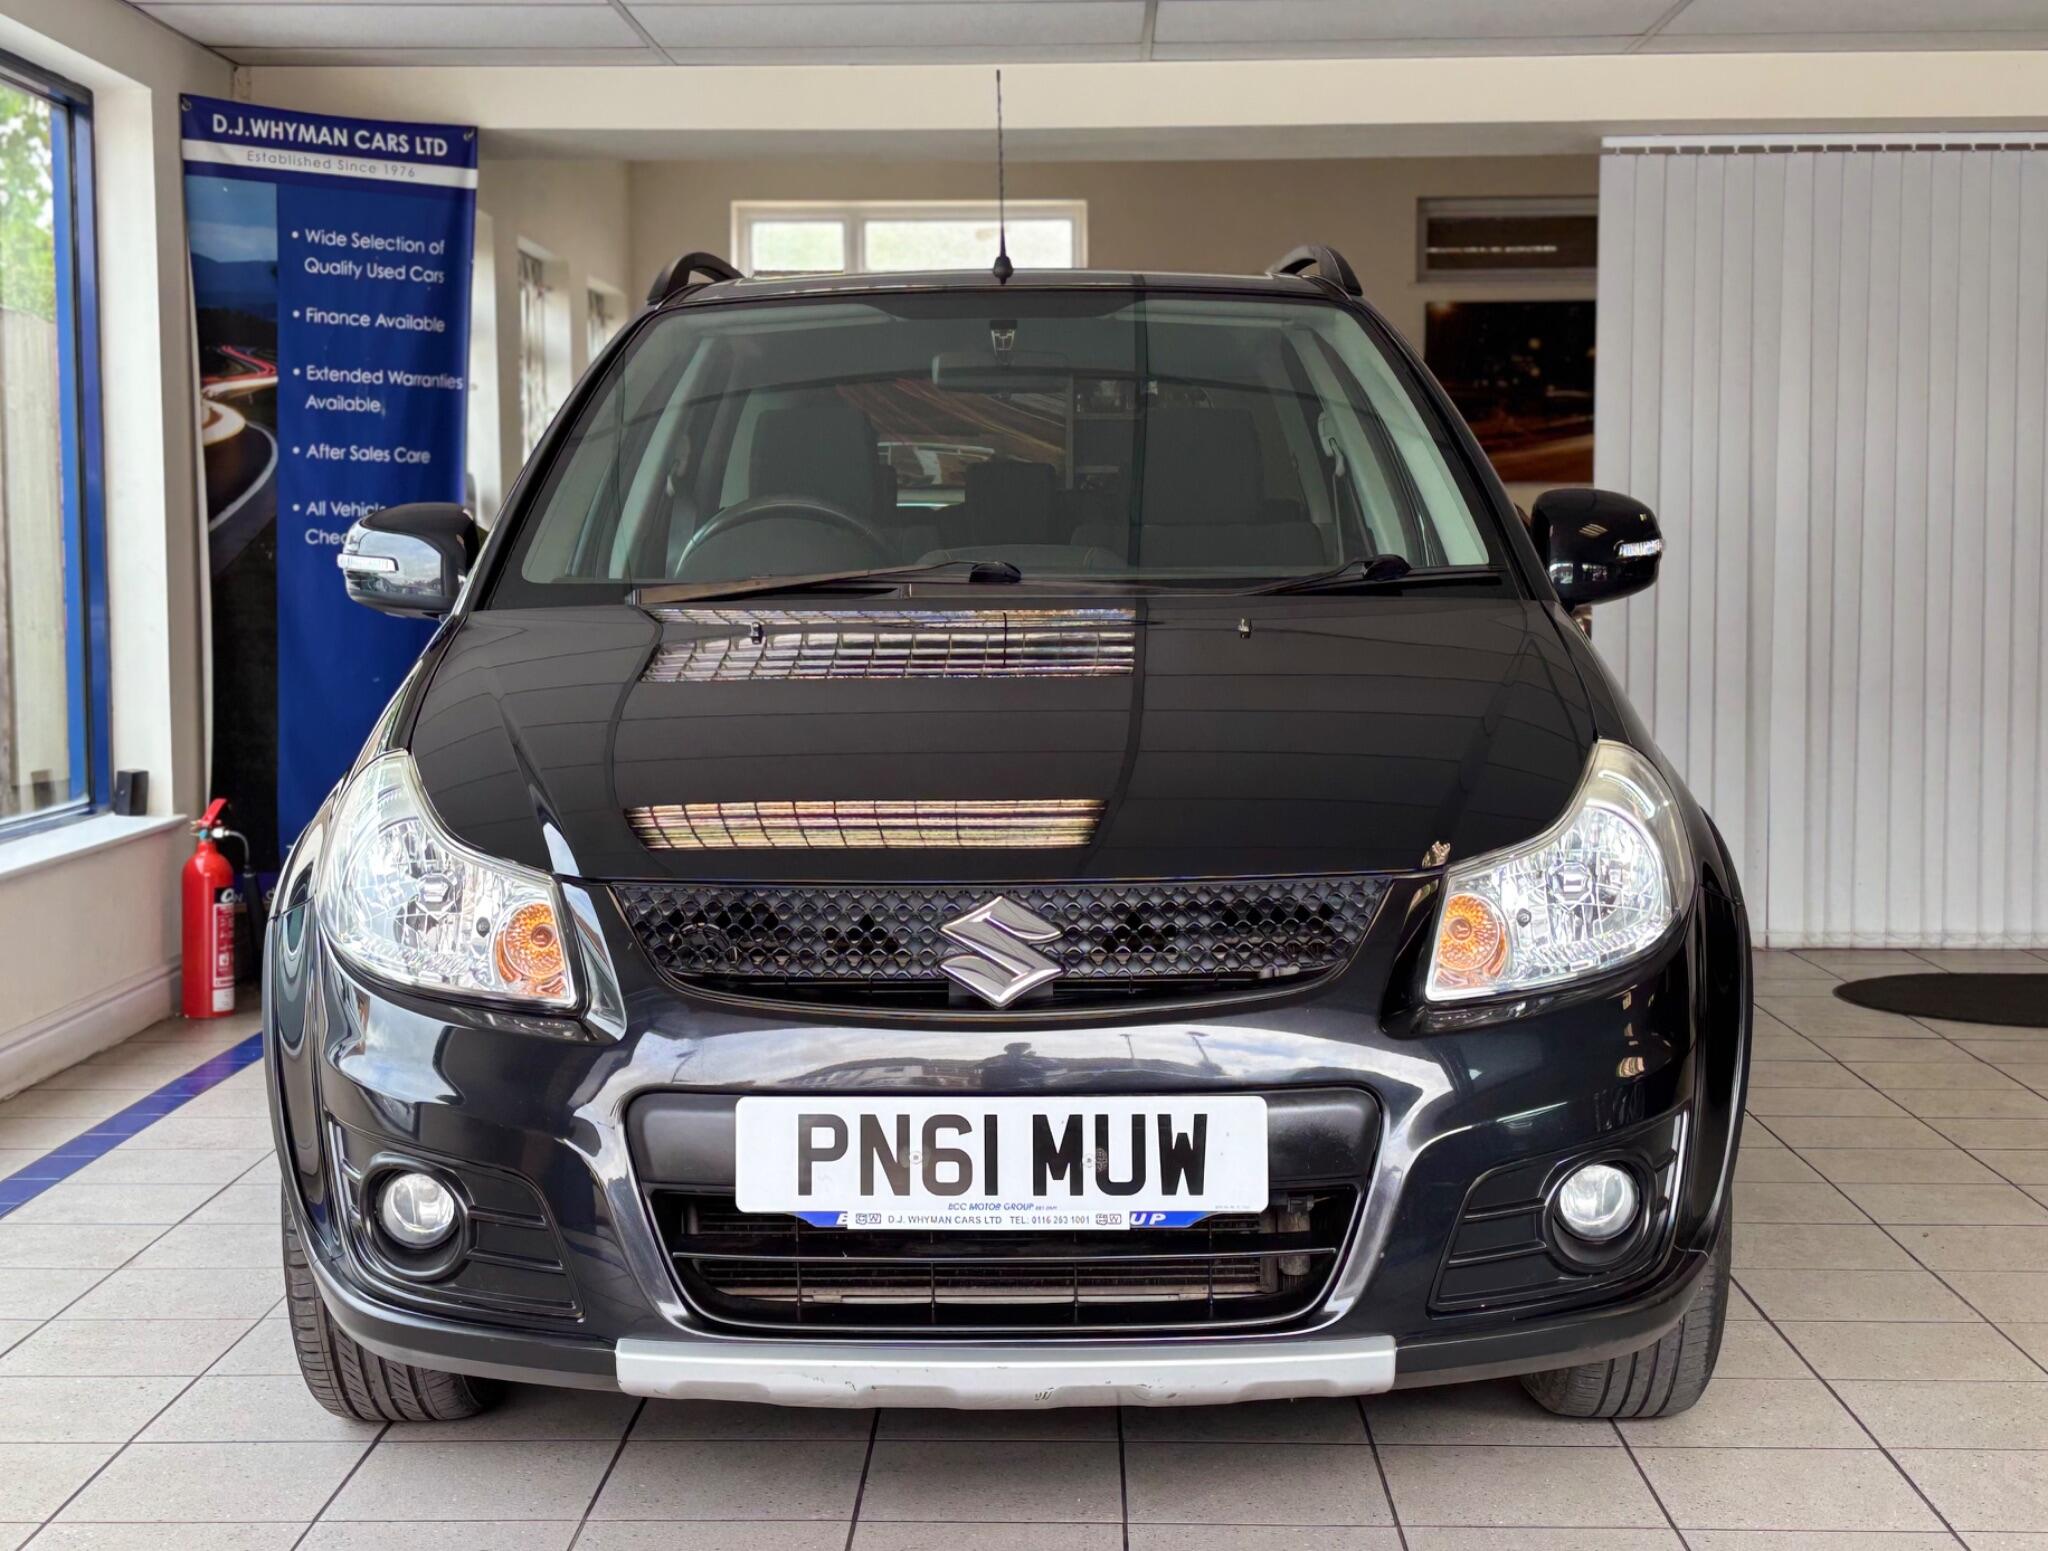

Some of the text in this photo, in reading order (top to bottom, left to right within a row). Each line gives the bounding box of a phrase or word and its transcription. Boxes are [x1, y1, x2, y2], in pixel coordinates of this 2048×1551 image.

[354, 130, 410, 154] CARS
[415, 136, 448, 157] LTD
[247, 150, 416, 178] Established Since 1976
[305, 228, 446, 255] Wide Selection of
[304, 257, 445, 284] Quality Used Cars
[305, 307, 446, 333] Finance Available
[305, 364, 464, 390] Extended Warranties
[305, 443, 431, 464] After Sales Care
[305, 500, 326, 516] All
[797, 1113, 1208, 1197] PN61 MUW
[1003, 1202, 1034, 1211] GROUP
[907, 1215, 951, 1224] WHYMAN
[954, 1215, 982, 1224] CARS
[984, 1215, 1001, 1224] LTD
[1031, 1215, 1052, 1224] 0116
[1071, 1215, 1090, 1225] 1001
